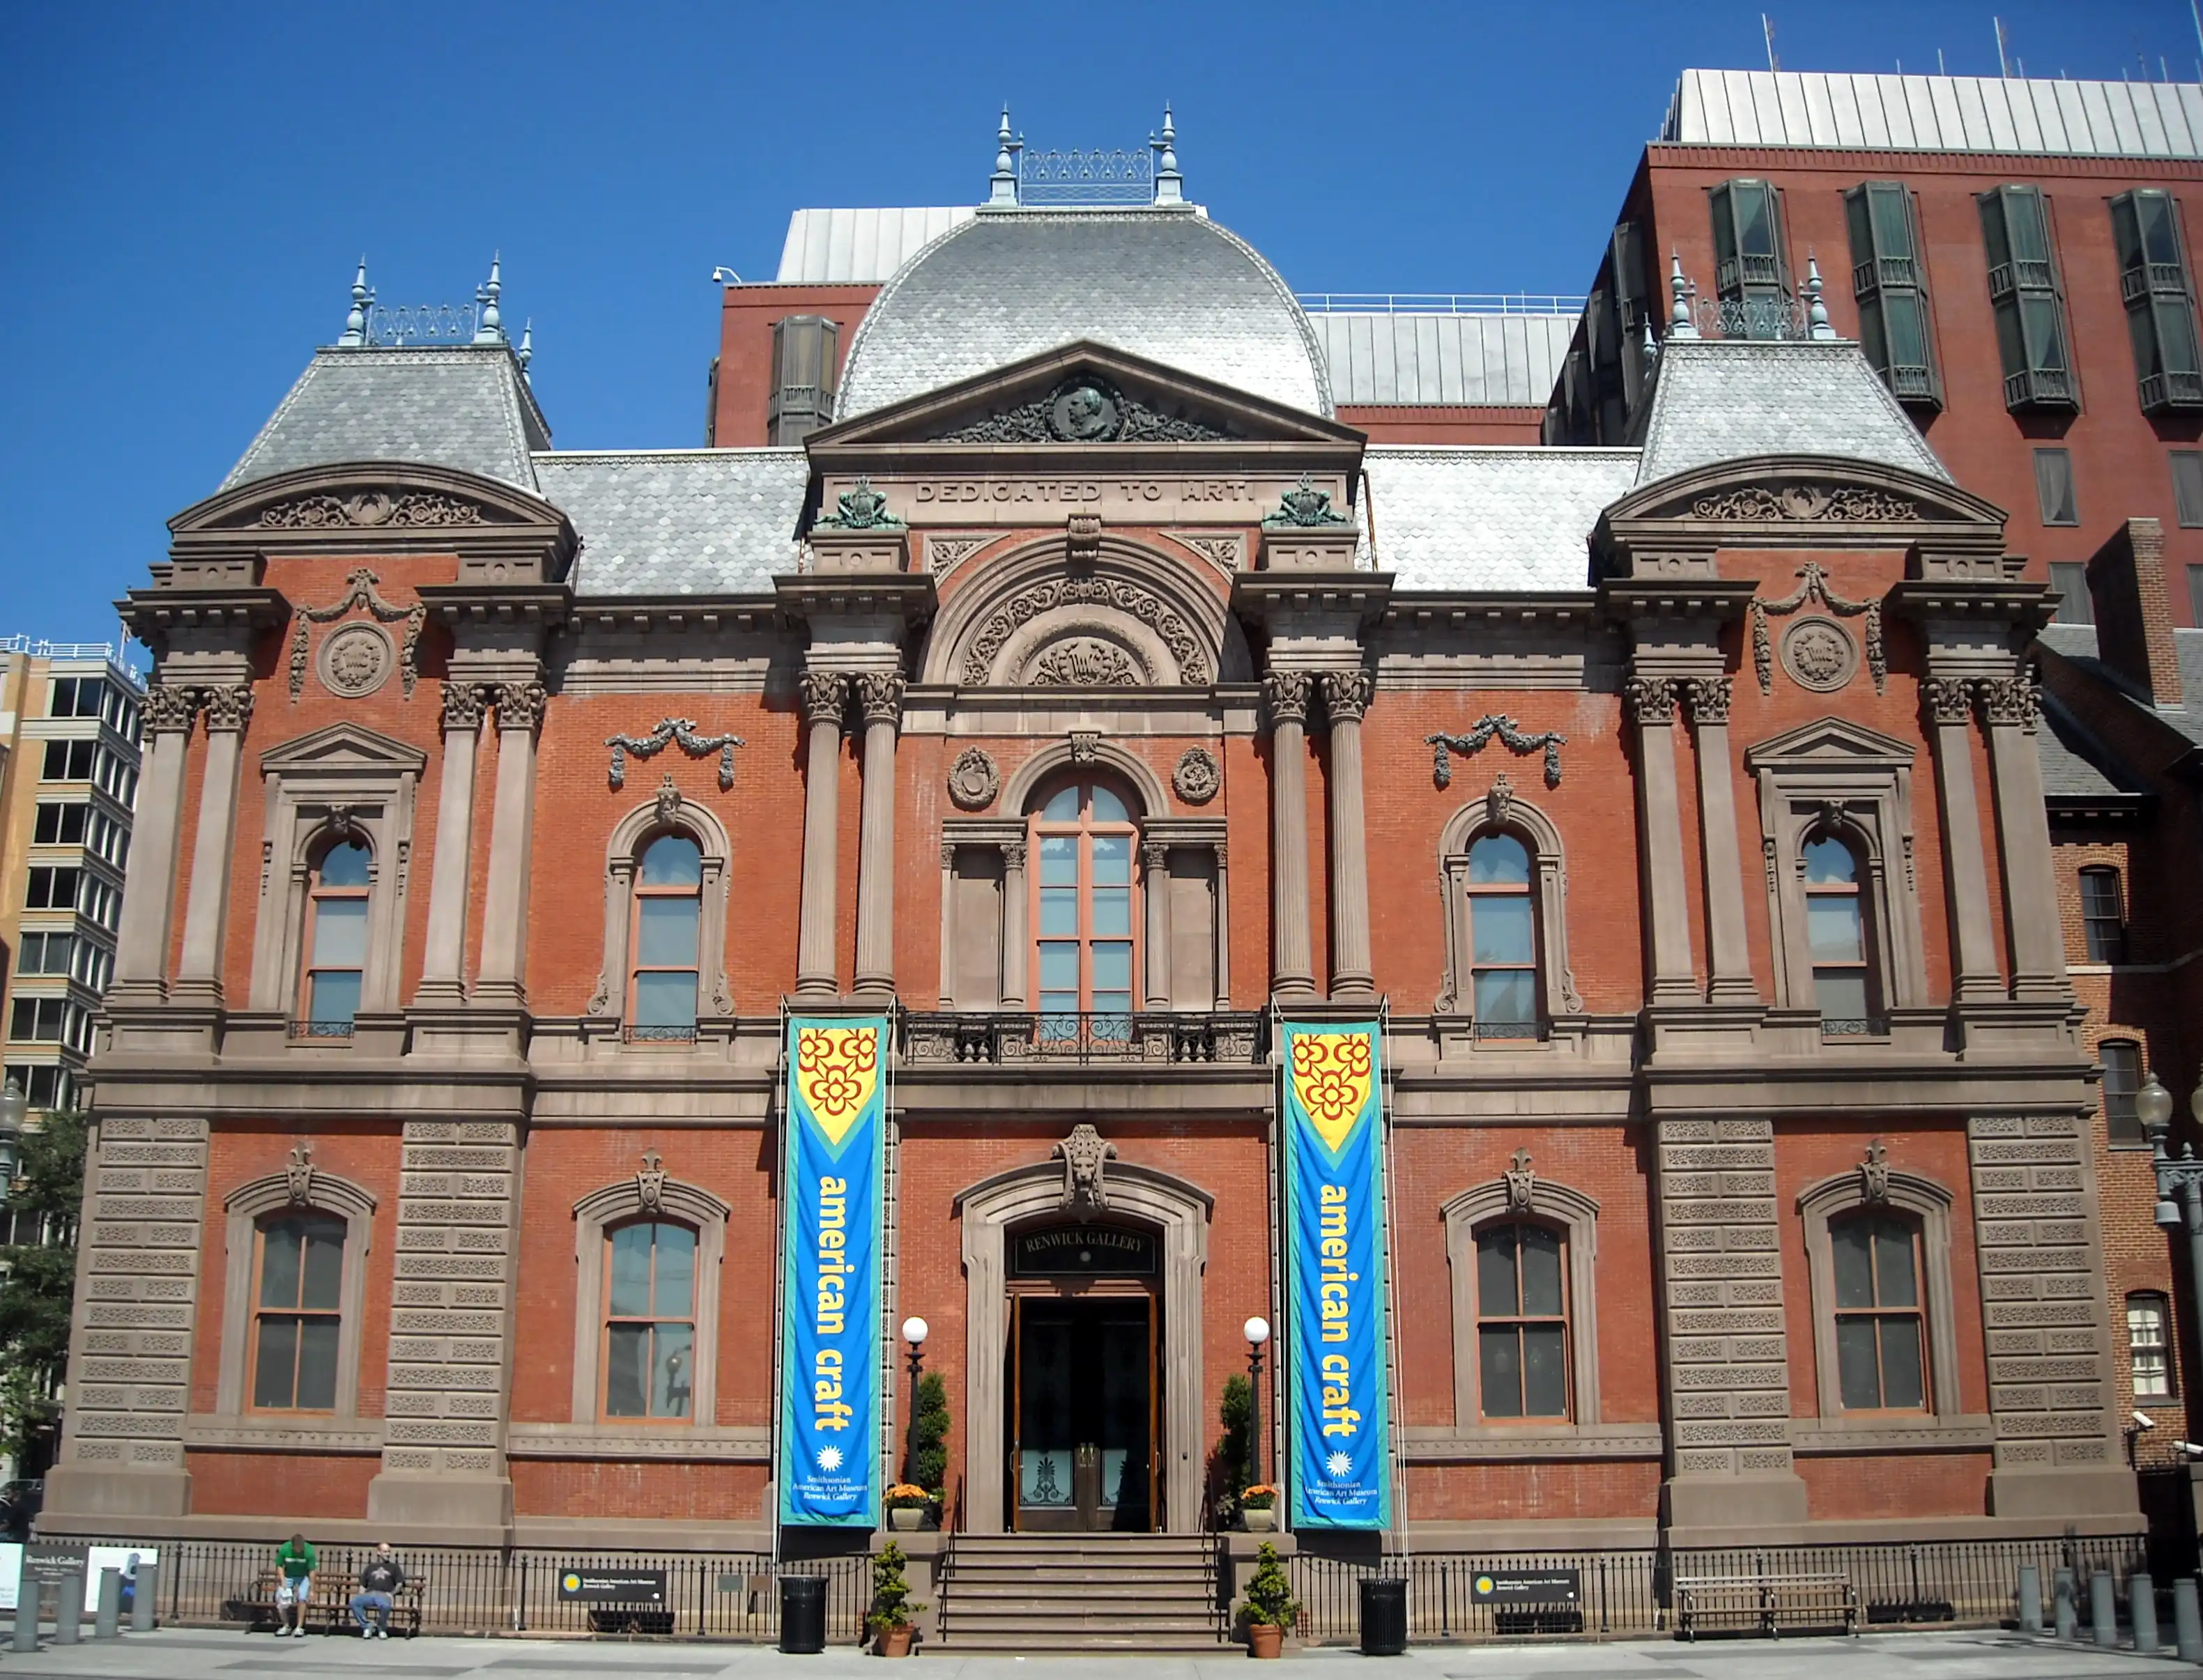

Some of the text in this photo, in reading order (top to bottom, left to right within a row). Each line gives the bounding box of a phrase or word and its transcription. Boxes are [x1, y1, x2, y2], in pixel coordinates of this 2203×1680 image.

[916, 481, 1254, 502] DEDICATED TO ART.
[1026, 1231, 1142, 1253] RENWICK GALLERY
[814, 1176, 855, 1432] american craft
[1320, 1185, 1361, 1438] american craft
[806, 1475, 852, 1484] Smithsonian
[1317, 1479, 1361, 1488] Smithsonian
[792, 1483, 868, 1493] American Art Museum
[1335, 1488, 1347, 1497] Art
[1349, 1488, 1378, 1497] Museum
[803, 1492, 858, 1502] Renwick Gallery
[1342, 1497, 1367, 1506] Gallery
[26, 1555, 84, 1568] Renwick Gallery
